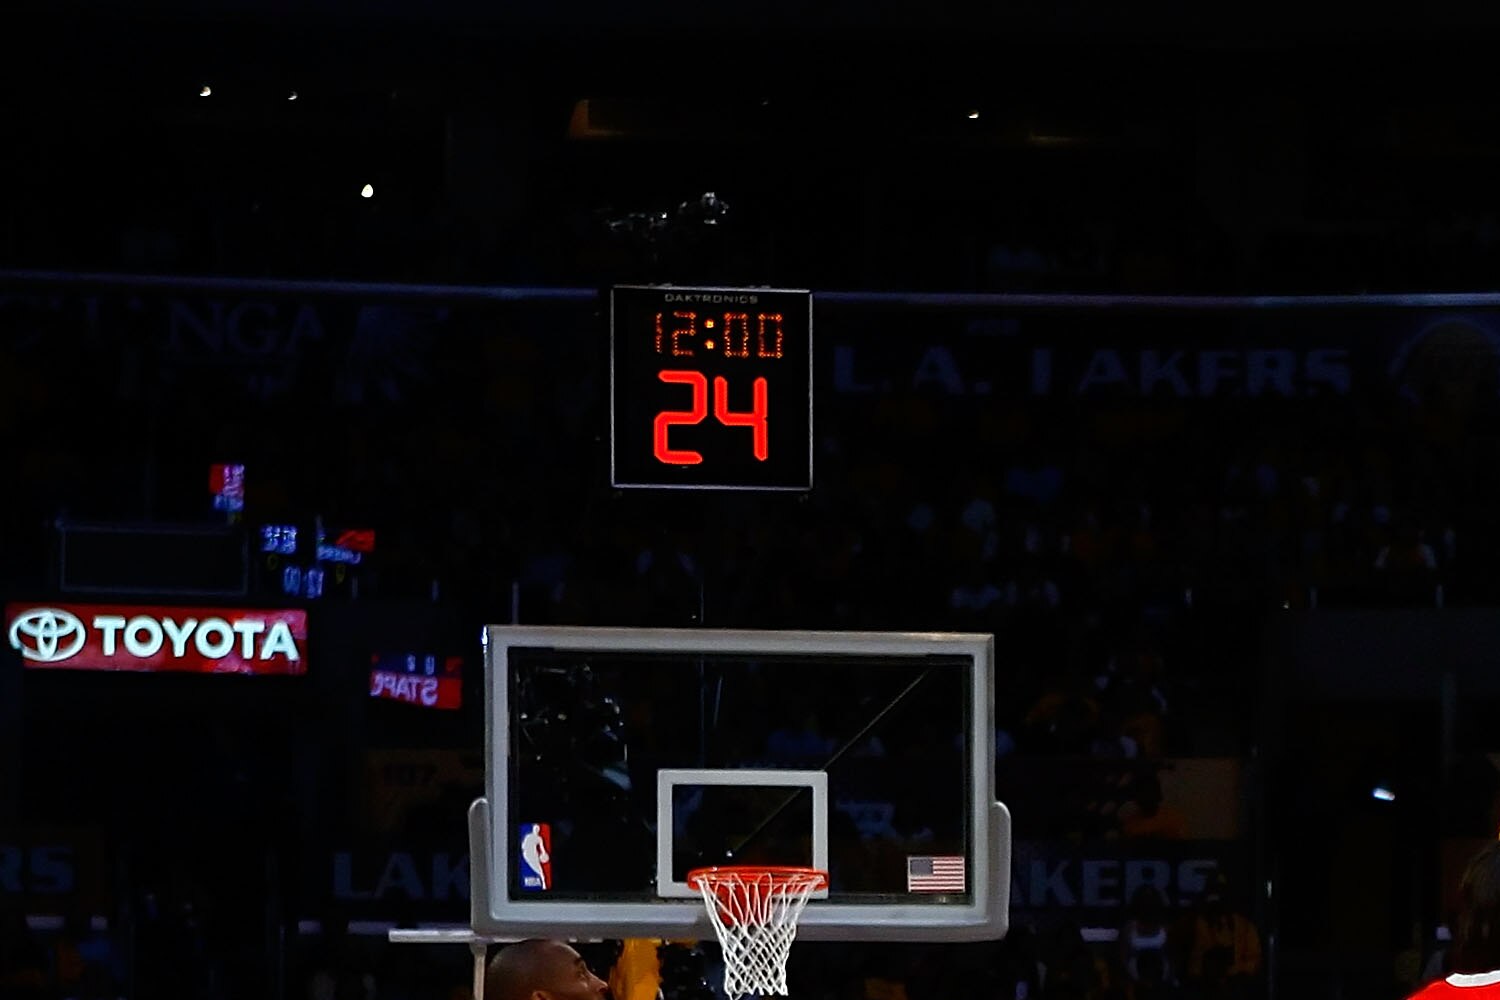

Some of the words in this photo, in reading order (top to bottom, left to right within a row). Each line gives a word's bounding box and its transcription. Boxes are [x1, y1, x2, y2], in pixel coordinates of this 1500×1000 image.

[655, 311, 784, 359] 12:00
[653, 369, 769, 465] 24
[93, 614, 301, 662] TOYOTA
[332, 850, 471, 900] LAK
[1012, 857, 1219, 907] KERS
